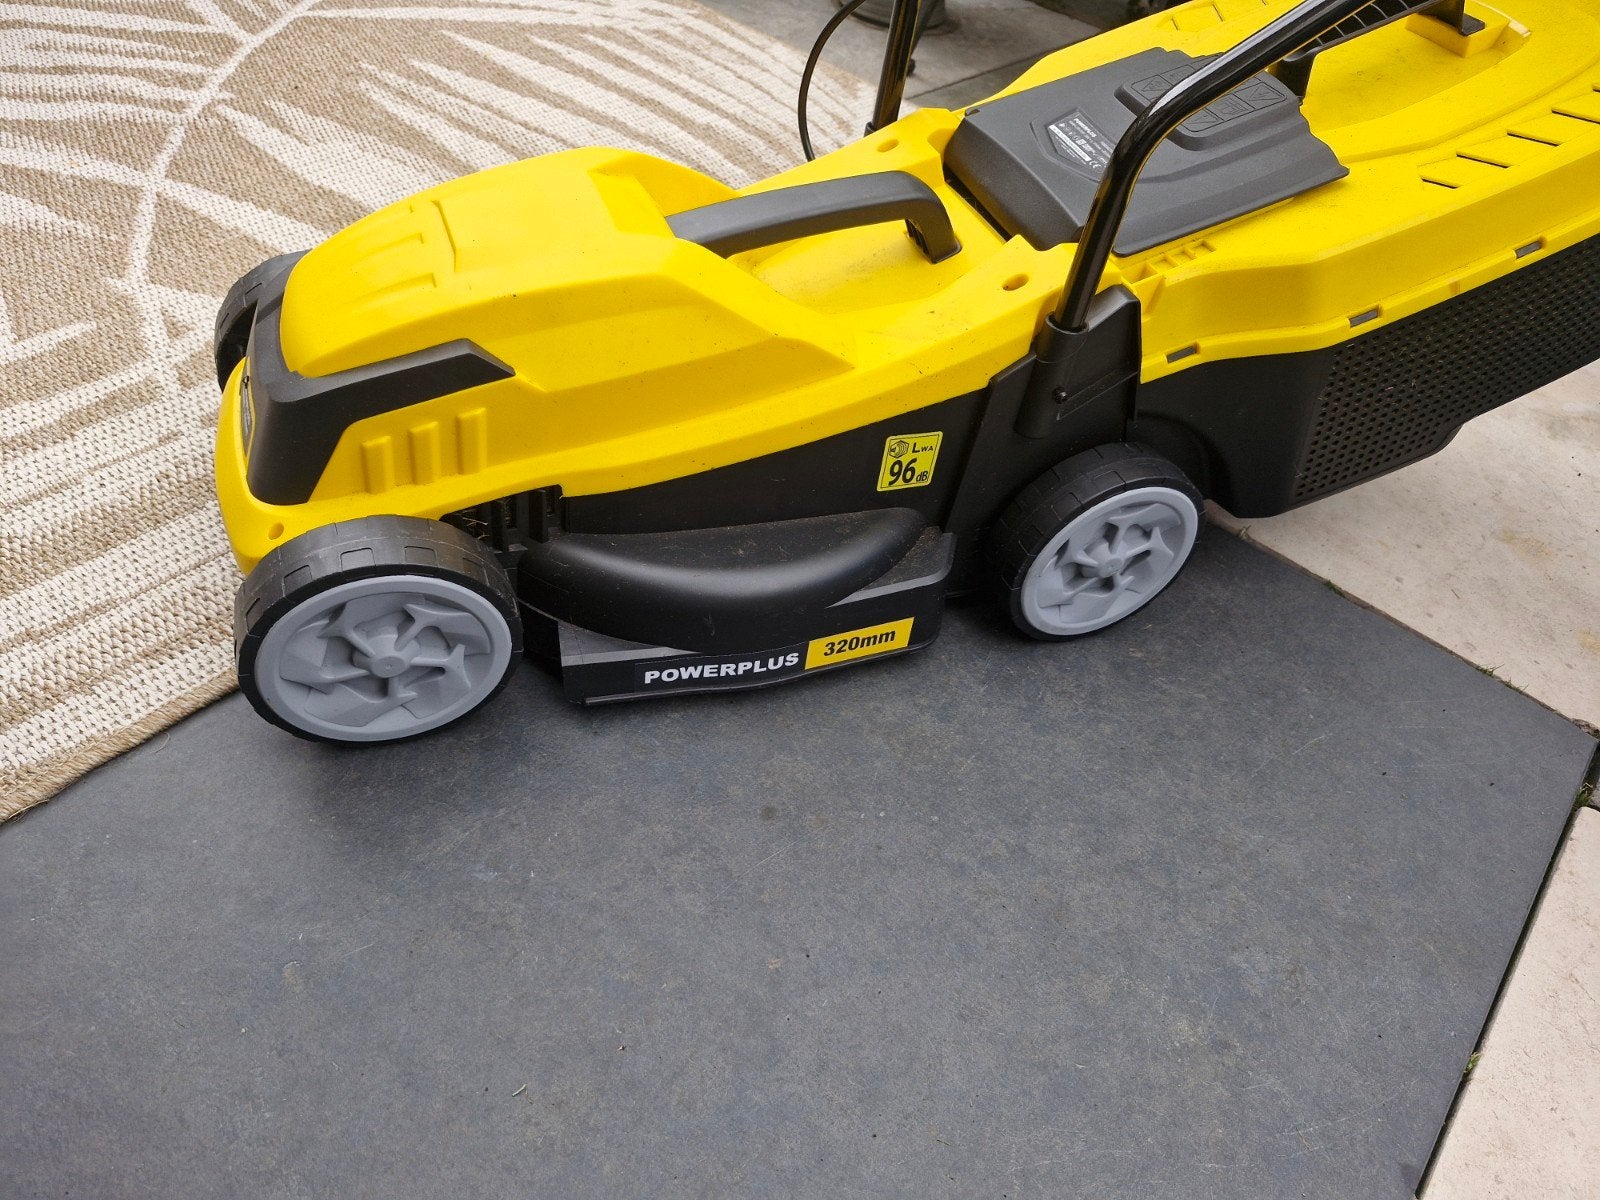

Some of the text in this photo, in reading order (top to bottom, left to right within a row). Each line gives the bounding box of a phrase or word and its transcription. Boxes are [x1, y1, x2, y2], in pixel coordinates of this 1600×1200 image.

[888, 457, 928, 486] 96 dB
[644, 630, 896, 684] POWERPLUS 320mm
